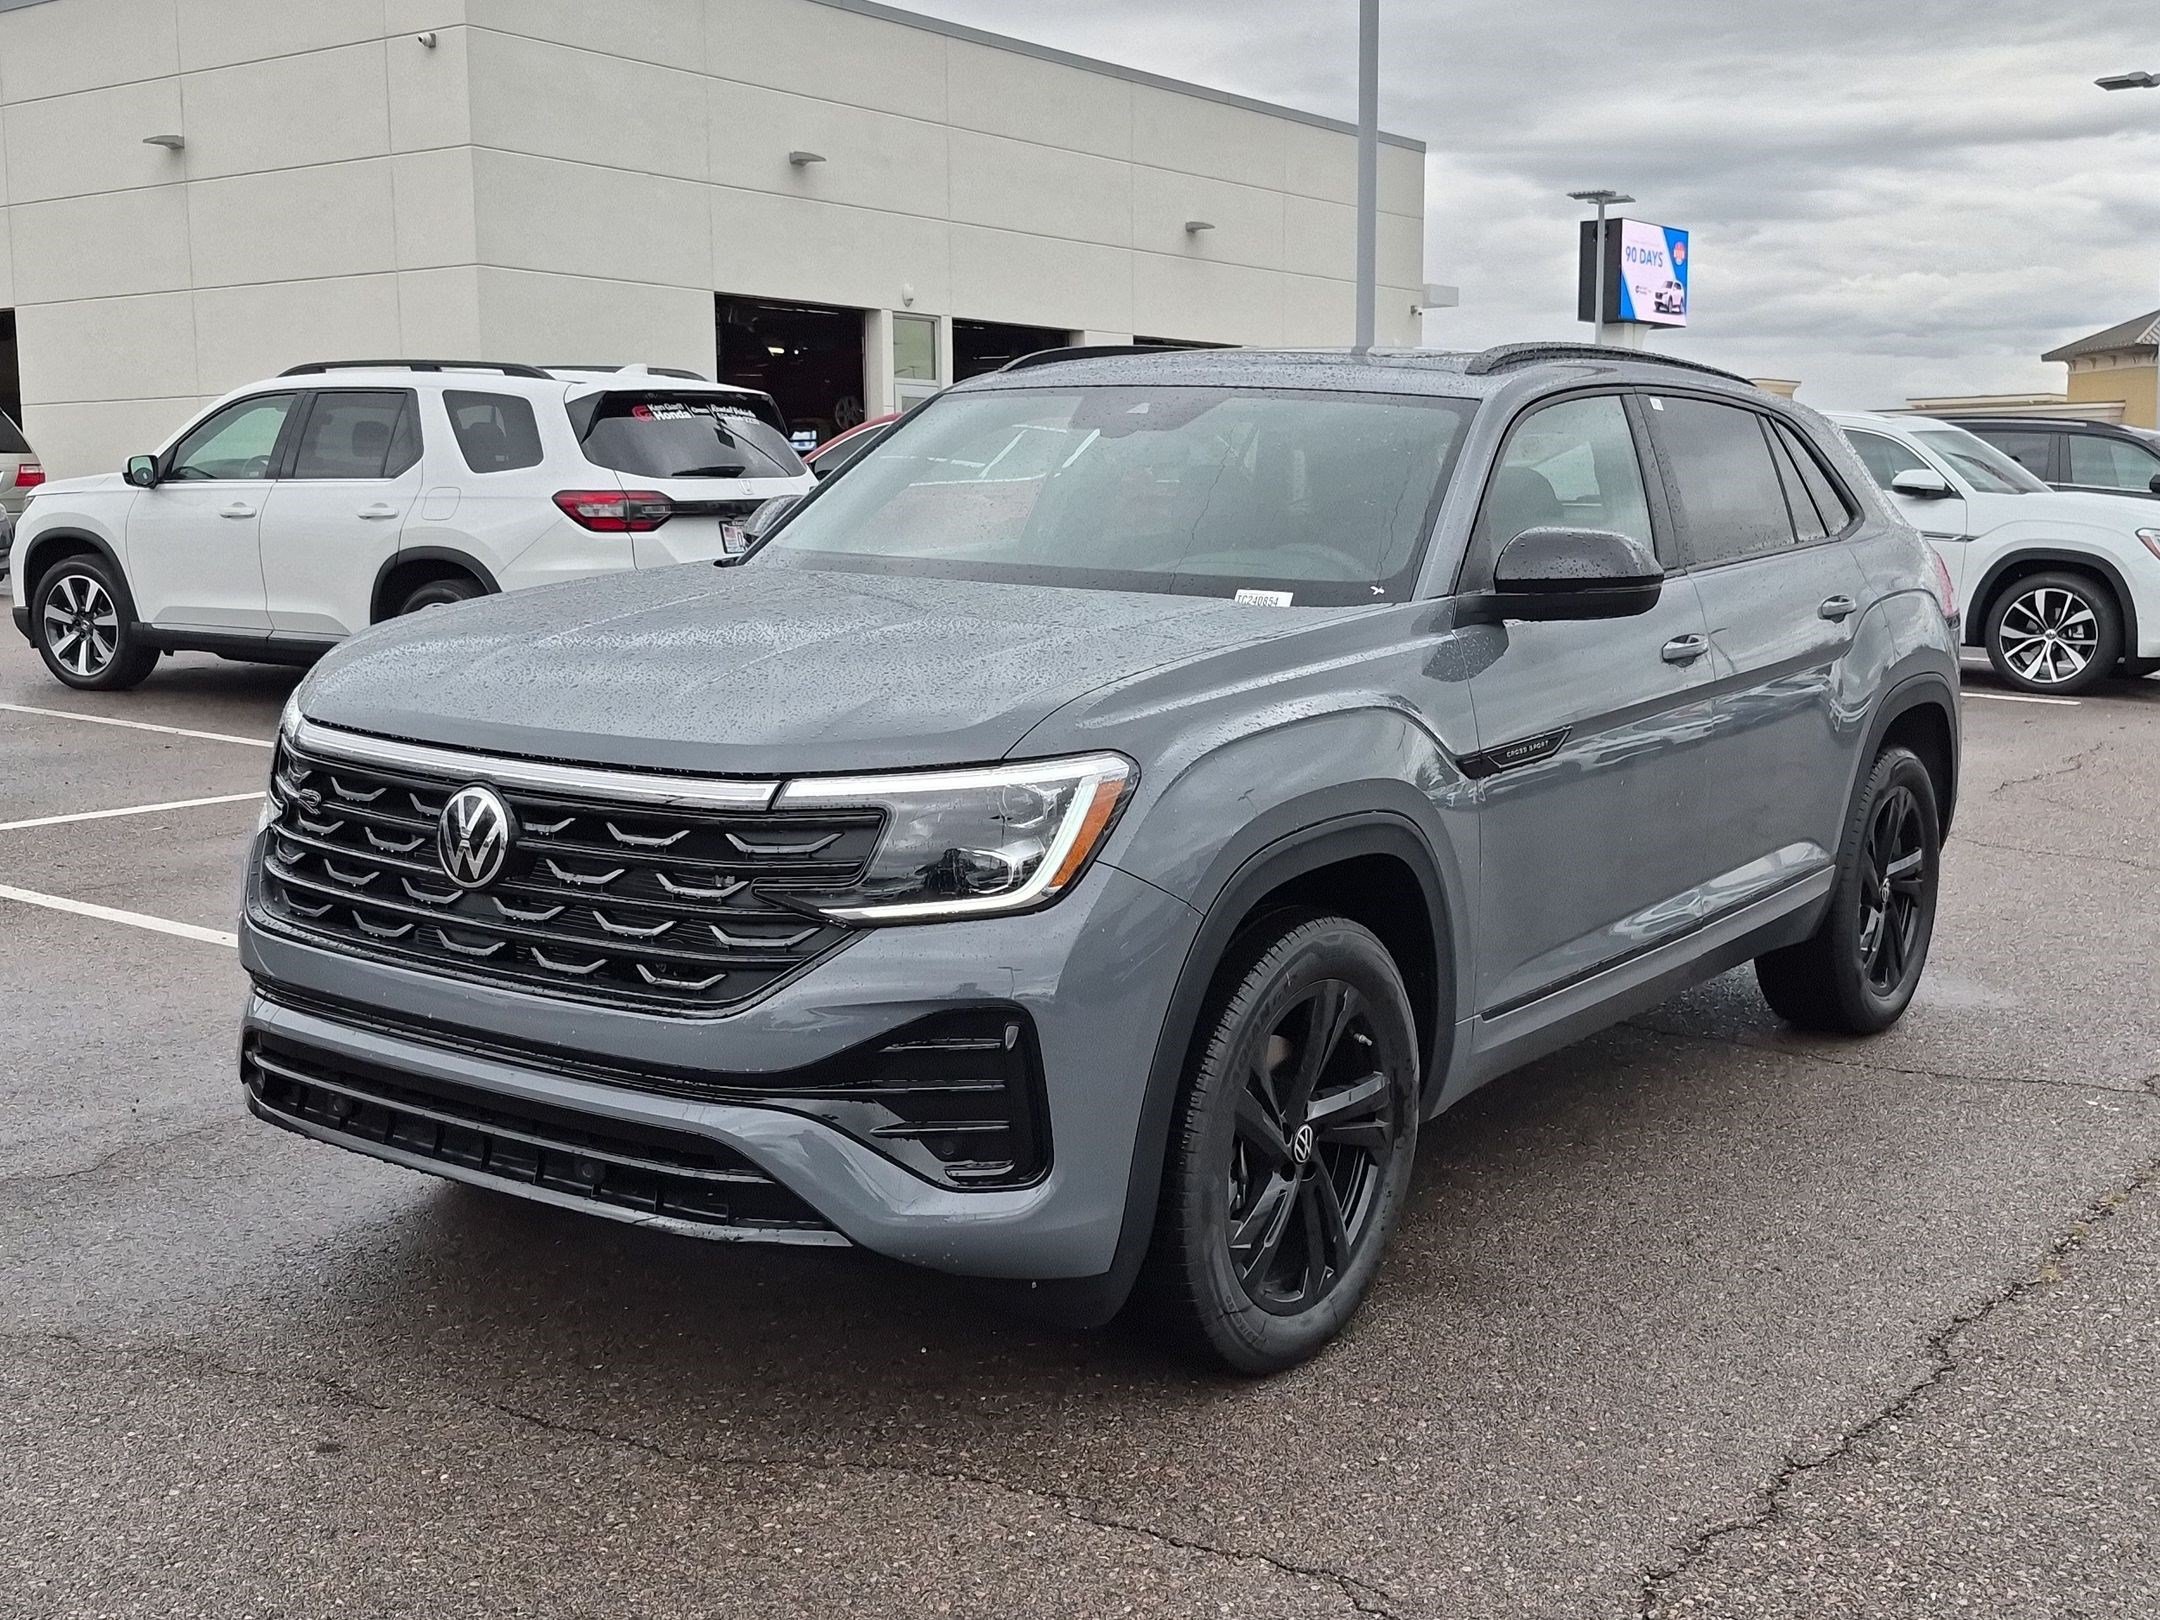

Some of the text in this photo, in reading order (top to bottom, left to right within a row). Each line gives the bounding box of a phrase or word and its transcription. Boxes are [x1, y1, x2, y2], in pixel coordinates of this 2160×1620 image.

[1625, 246, 1664, 268] 90 DAYS
[652, 410, 693, 421] Honda
[1506, 740, 1549, 758] CROSS SPORT
